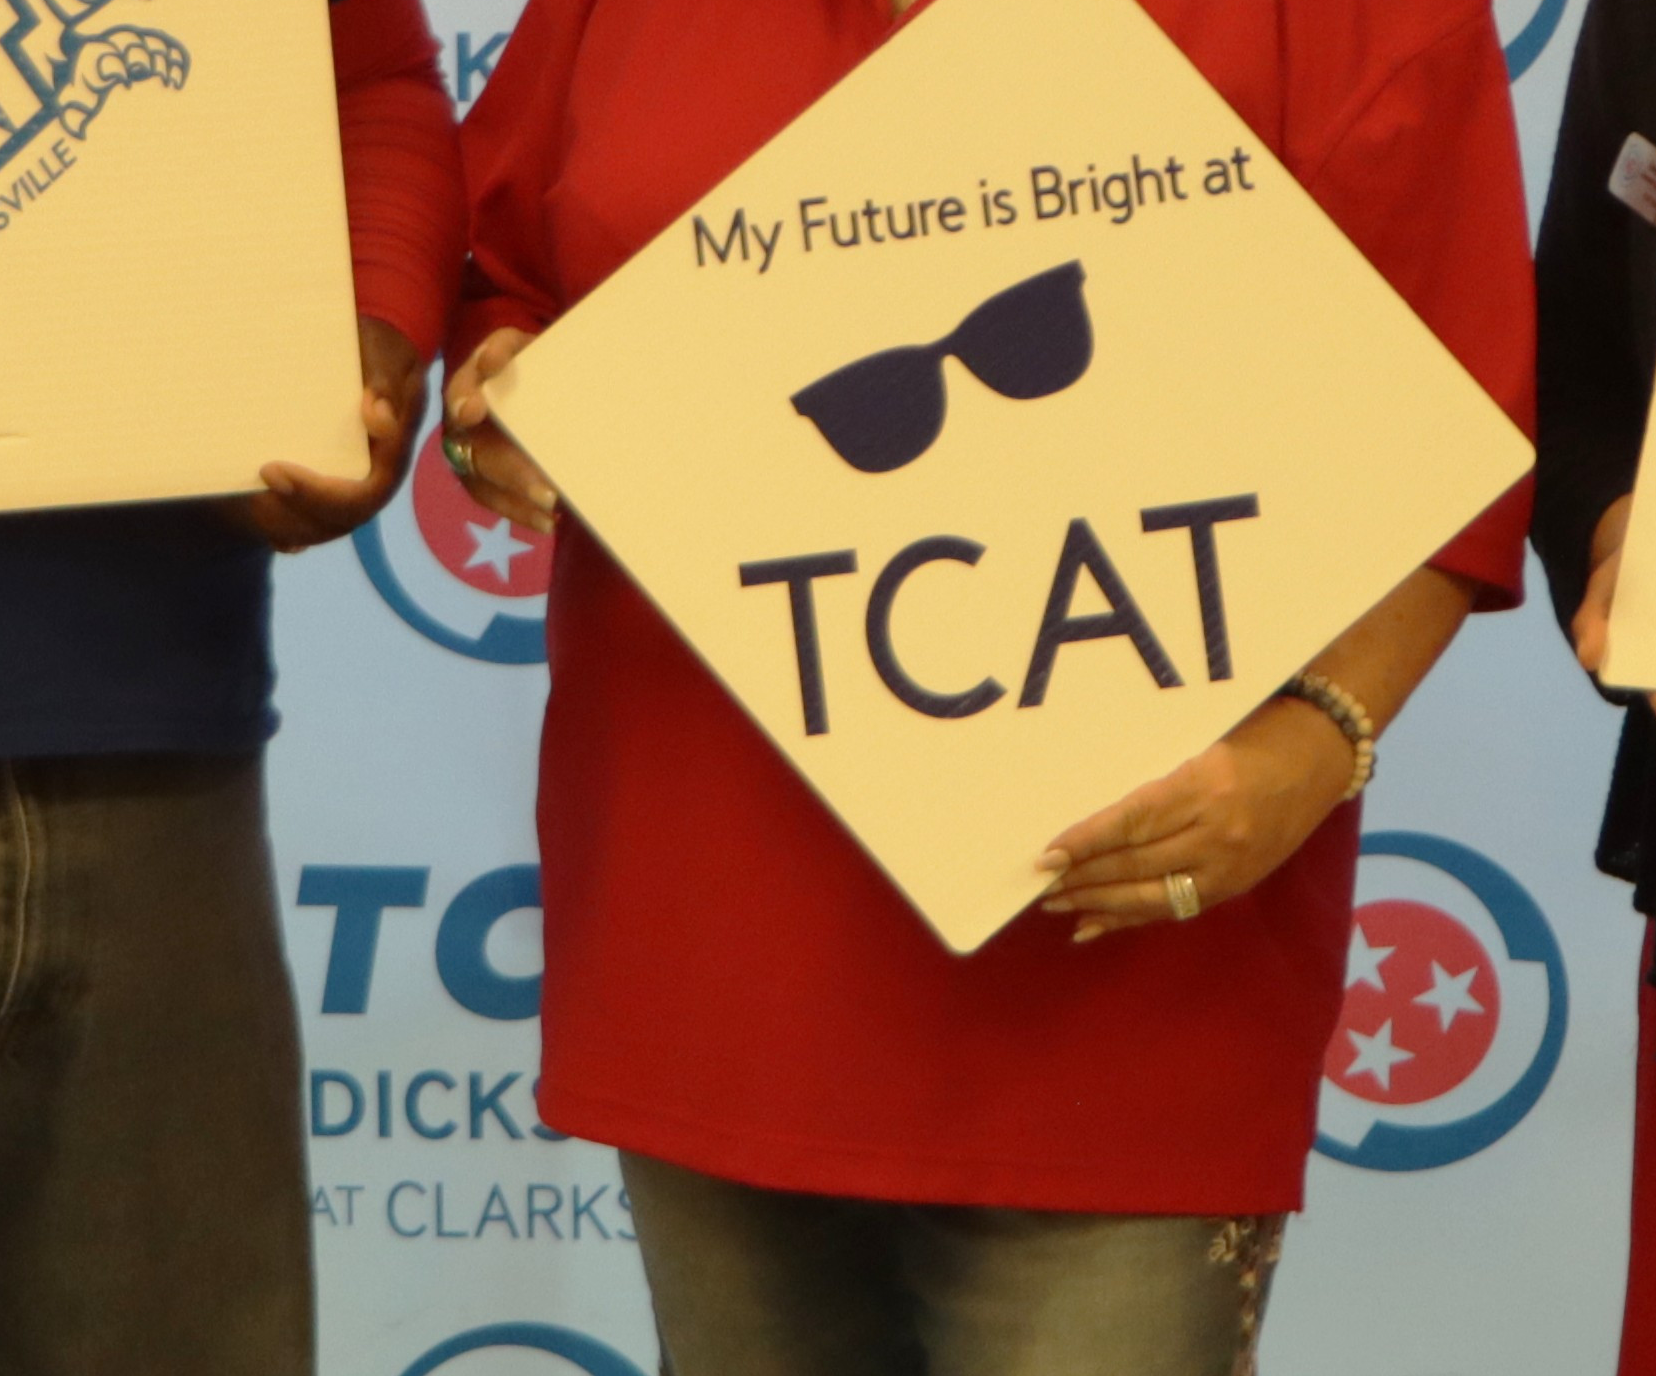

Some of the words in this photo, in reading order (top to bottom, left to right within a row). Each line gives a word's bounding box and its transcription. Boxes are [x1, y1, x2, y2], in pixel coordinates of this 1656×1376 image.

[691, 207, 783, 274] My
[799, 196, 966, 253] Future
[978, 179, 1019, 228] is
[1031, 155, 1188, 225] Bright
[1202, 147, 1254, 196] at
[739, 491, 1260, 737] TCAT
[308, 1185, 365, 1227] AT
